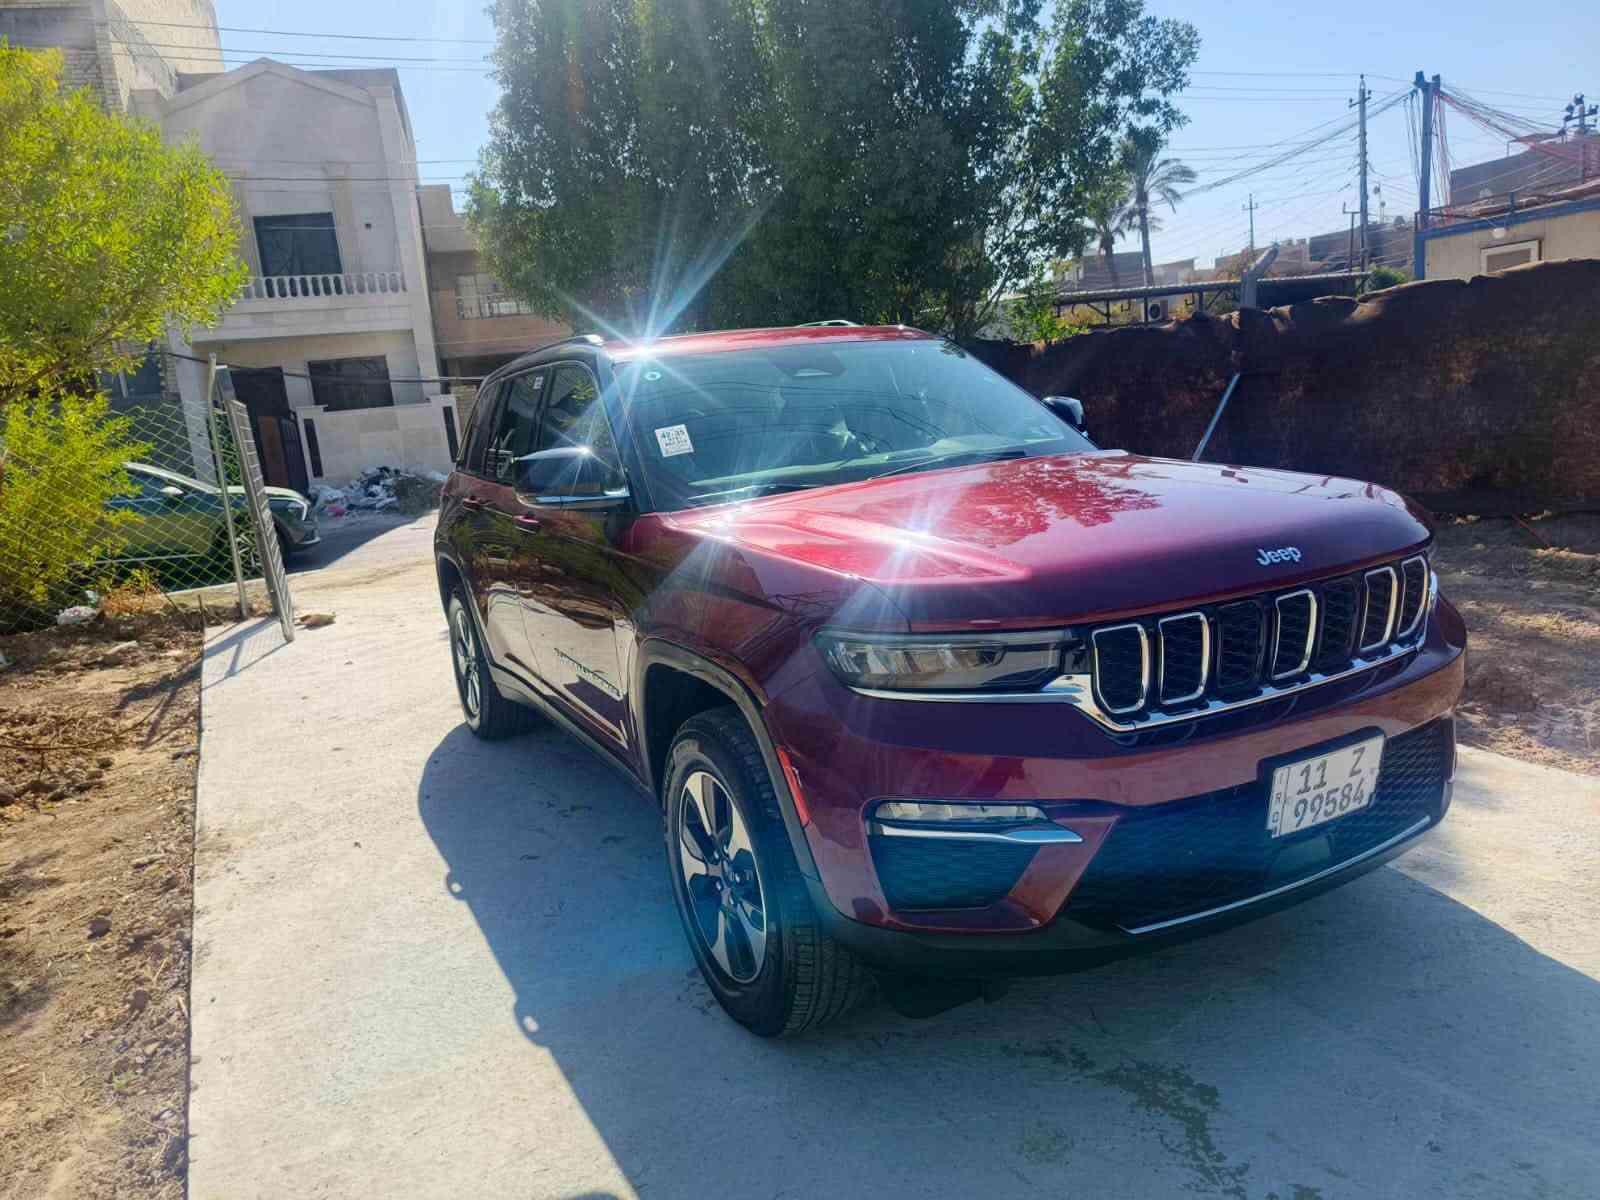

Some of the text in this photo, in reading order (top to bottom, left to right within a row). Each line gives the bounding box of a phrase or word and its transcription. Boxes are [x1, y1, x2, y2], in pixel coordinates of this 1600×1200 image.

[1256, 547, 1302, 566] Jeep
[1296, 746, 1366, 796] 11 Z
[1294, 777, 1366, 828] 99584
